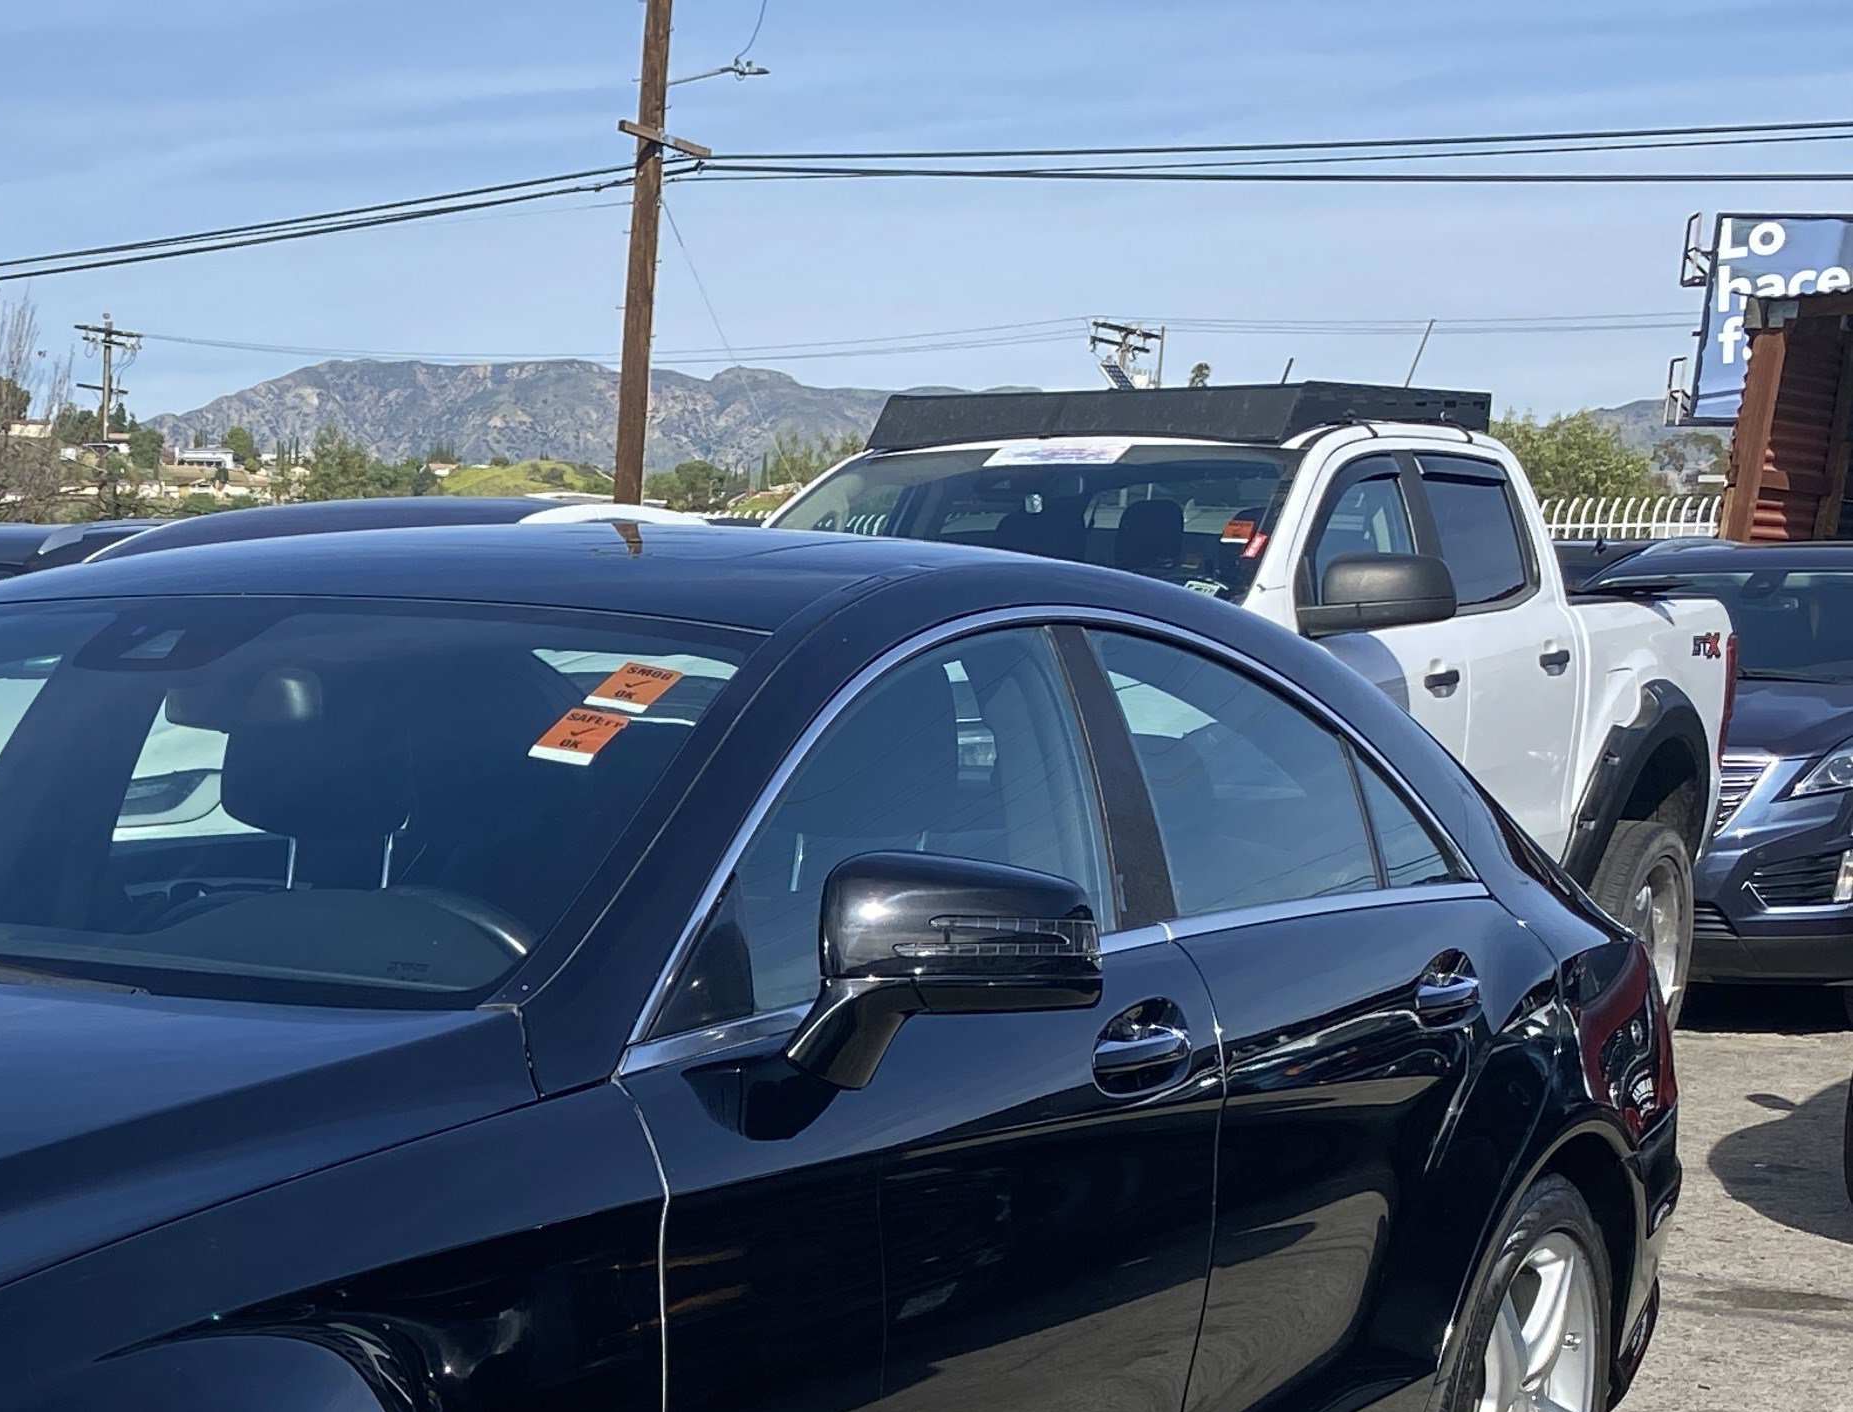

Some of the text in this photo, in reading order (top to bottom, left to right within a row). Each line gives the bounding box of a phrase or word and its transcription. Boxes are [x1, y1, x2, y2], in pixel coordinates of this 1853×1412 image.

[1717, 217, 1786, 260] Lo
[626, 665, 674, 682] SMOG
[614, 689, 637, 700] OK
[566, 711, 626, 729] SAFETY
[558, 738, 583, 749] OK
